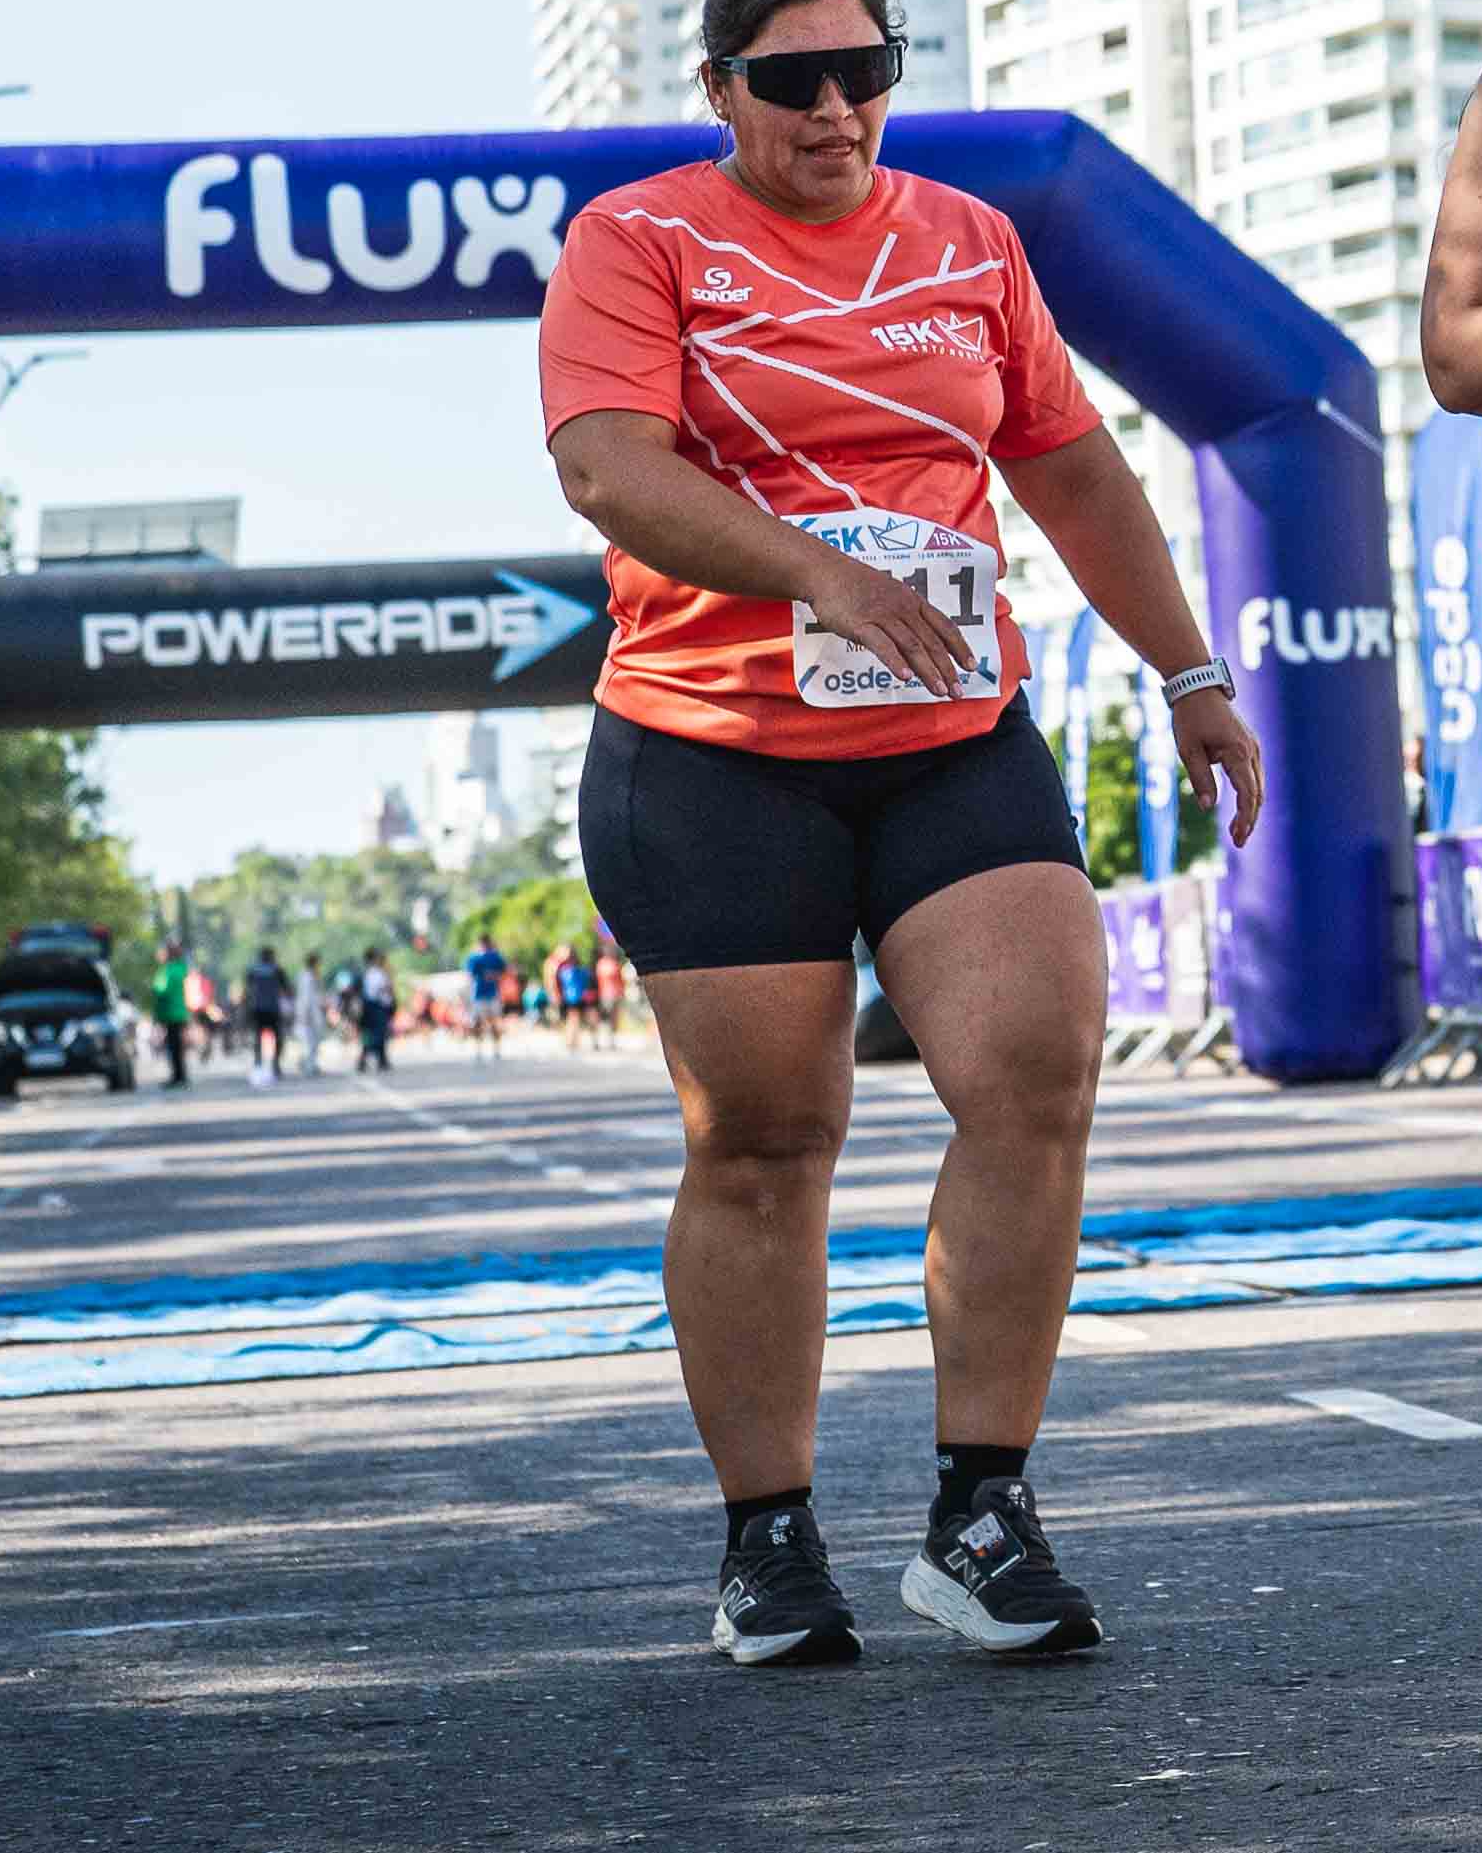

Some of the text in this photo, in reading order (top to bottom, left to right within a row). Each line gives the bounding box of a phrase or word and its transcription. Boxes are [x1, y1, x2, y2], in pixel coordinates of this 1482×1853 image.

[869, 318, 945, 349] 15K
[815, 525, 866, 552] 5K
[80, 593, 544, 670] POWERADE
[824, 666, 893, 694] osde
